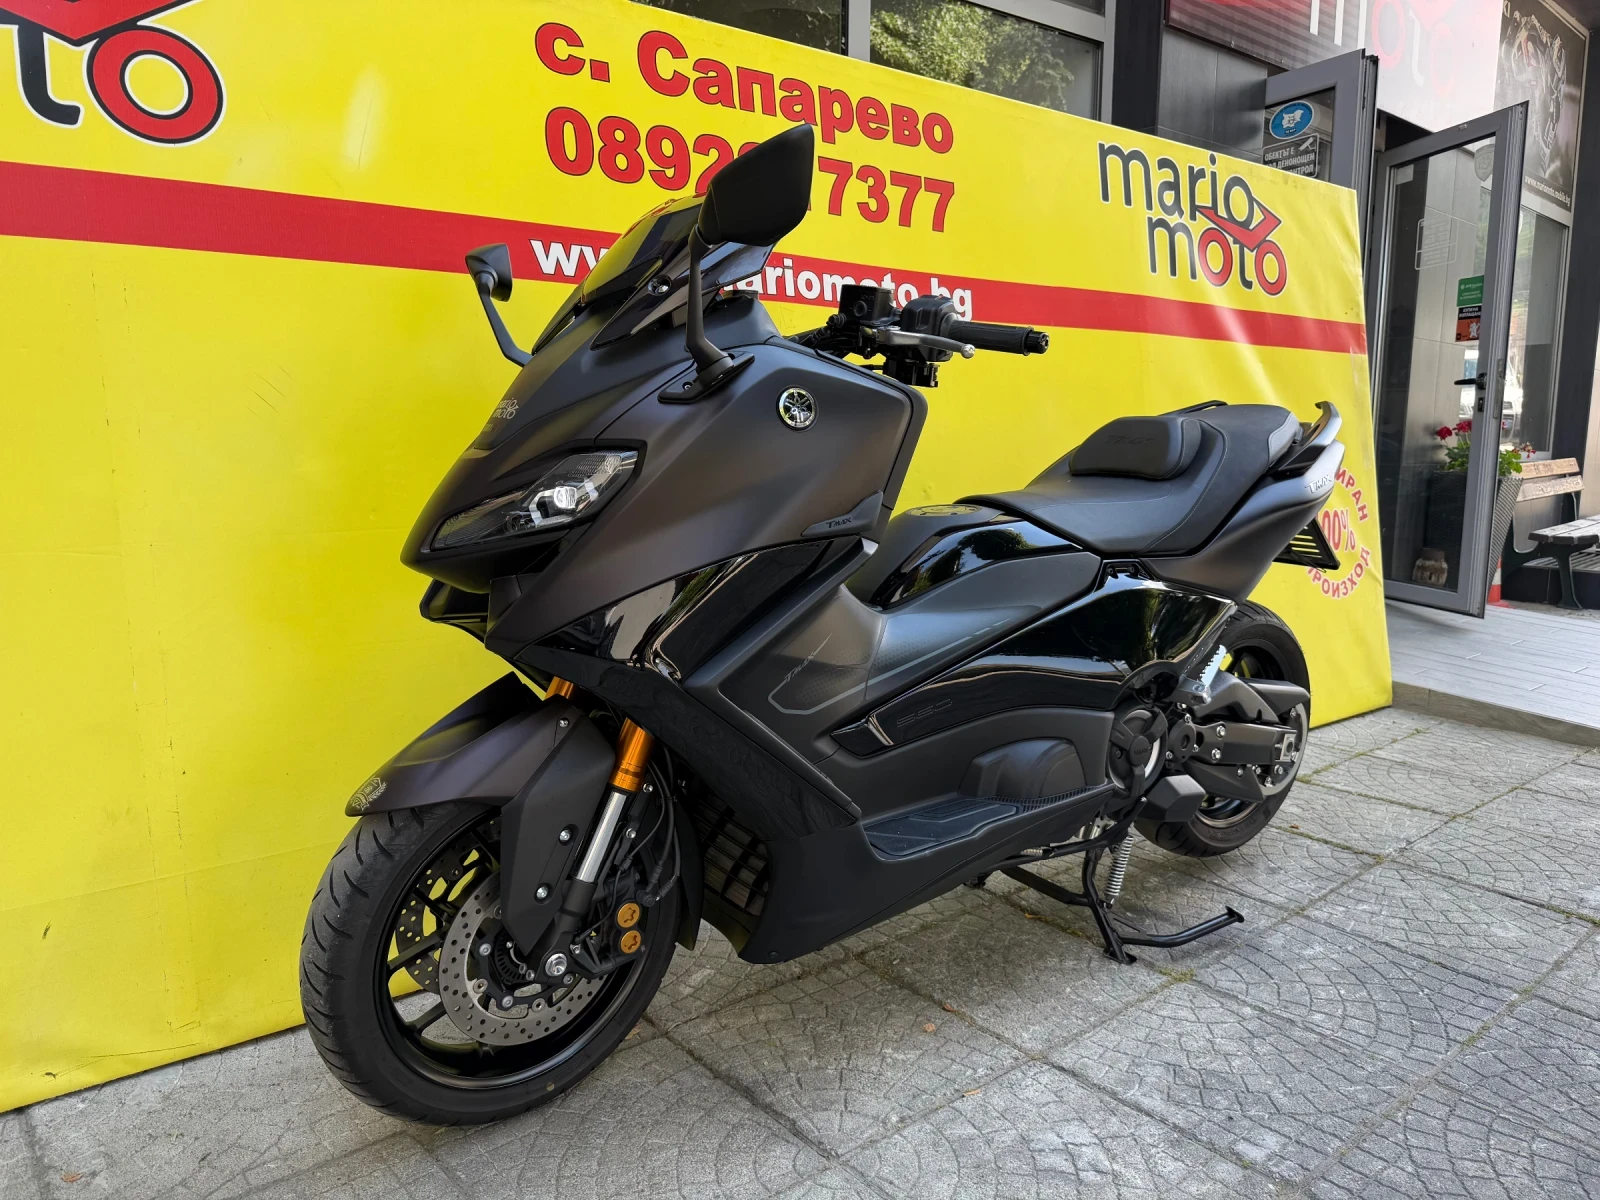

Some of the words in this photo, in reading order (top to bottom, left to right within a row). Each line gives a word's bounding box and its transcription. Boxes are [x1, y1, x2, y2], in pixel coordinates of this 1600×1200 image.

[535, 22, 610, 83] с.
[636, 30, 954, 154] Сапарево
[545, 106, 955, 233] 08927377
[1098, 142, 1255, 230] mario
[1146, 216, 1288, 297] moto
[1315, 508, 1356, 552] 00%
